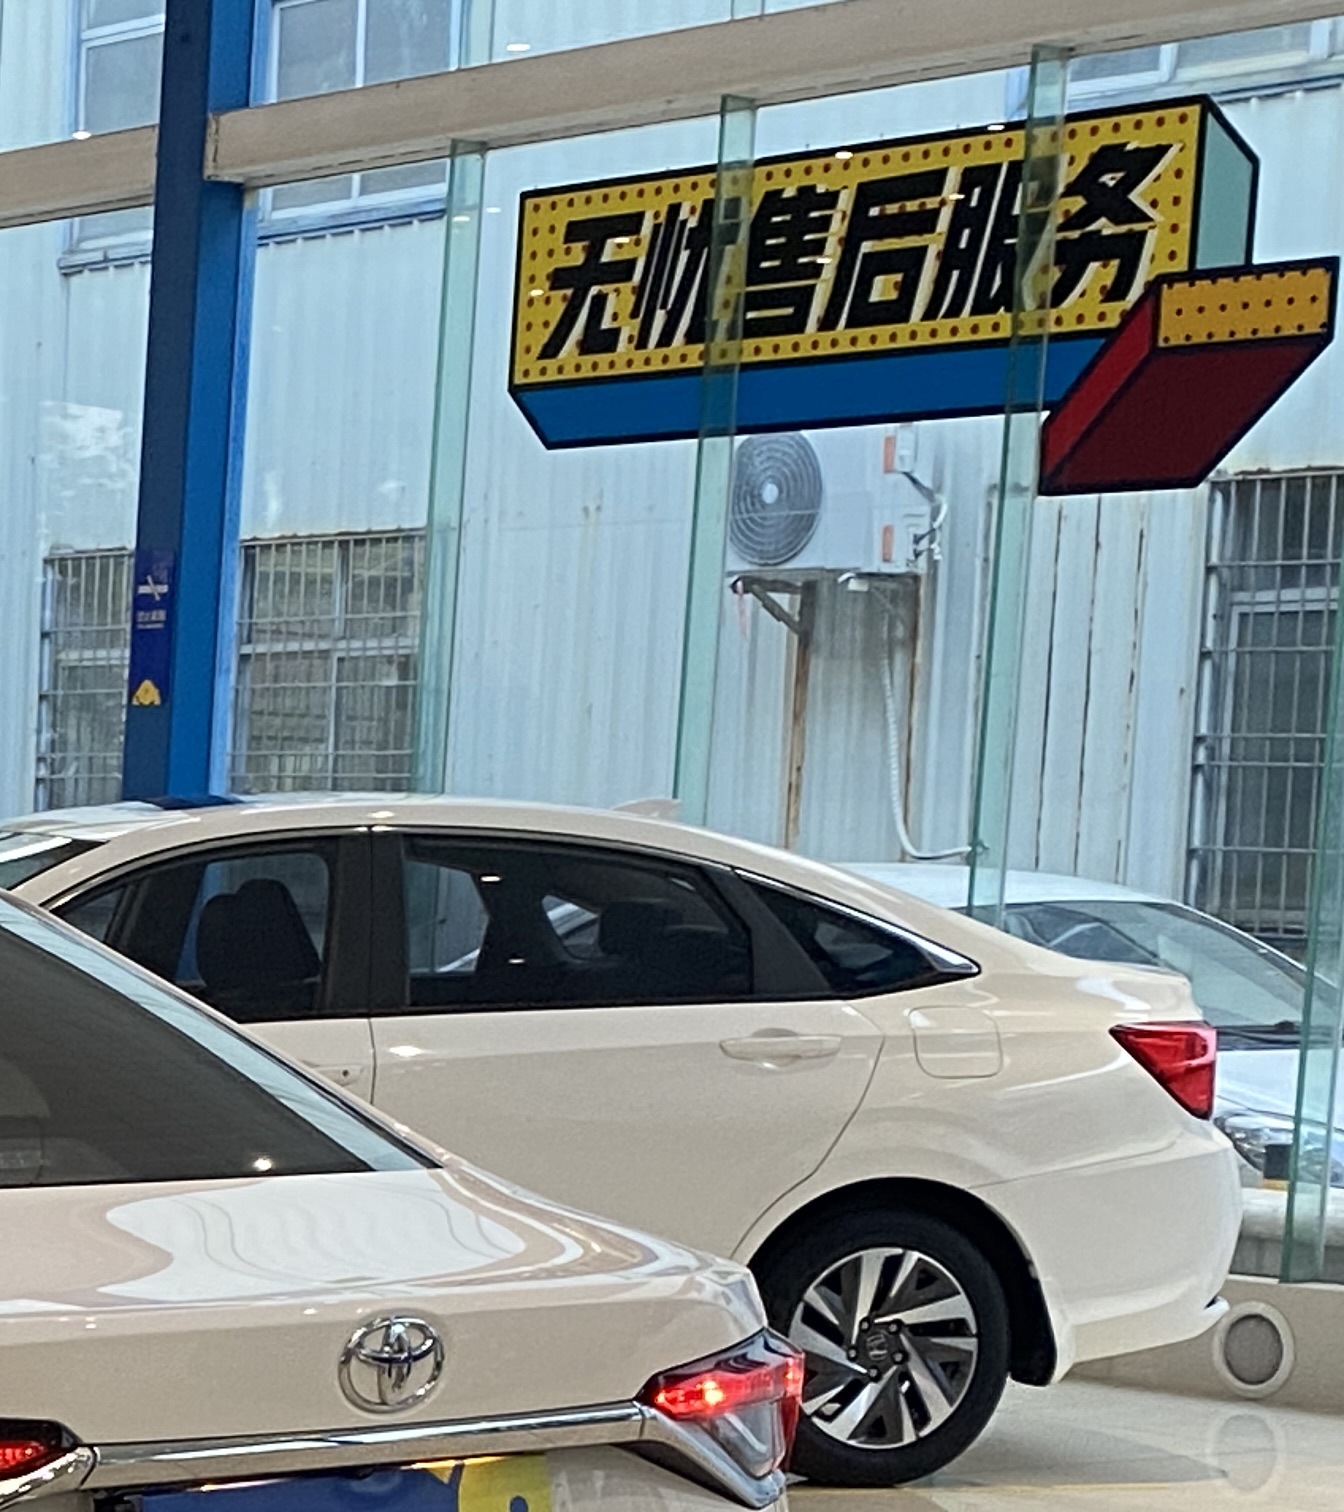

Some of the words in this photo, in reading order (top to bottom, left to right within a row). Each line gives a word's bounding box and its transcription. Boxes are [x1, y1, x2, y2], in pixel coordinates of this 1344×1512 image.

[539, 142, 1182, 361] 无忧售后服务
